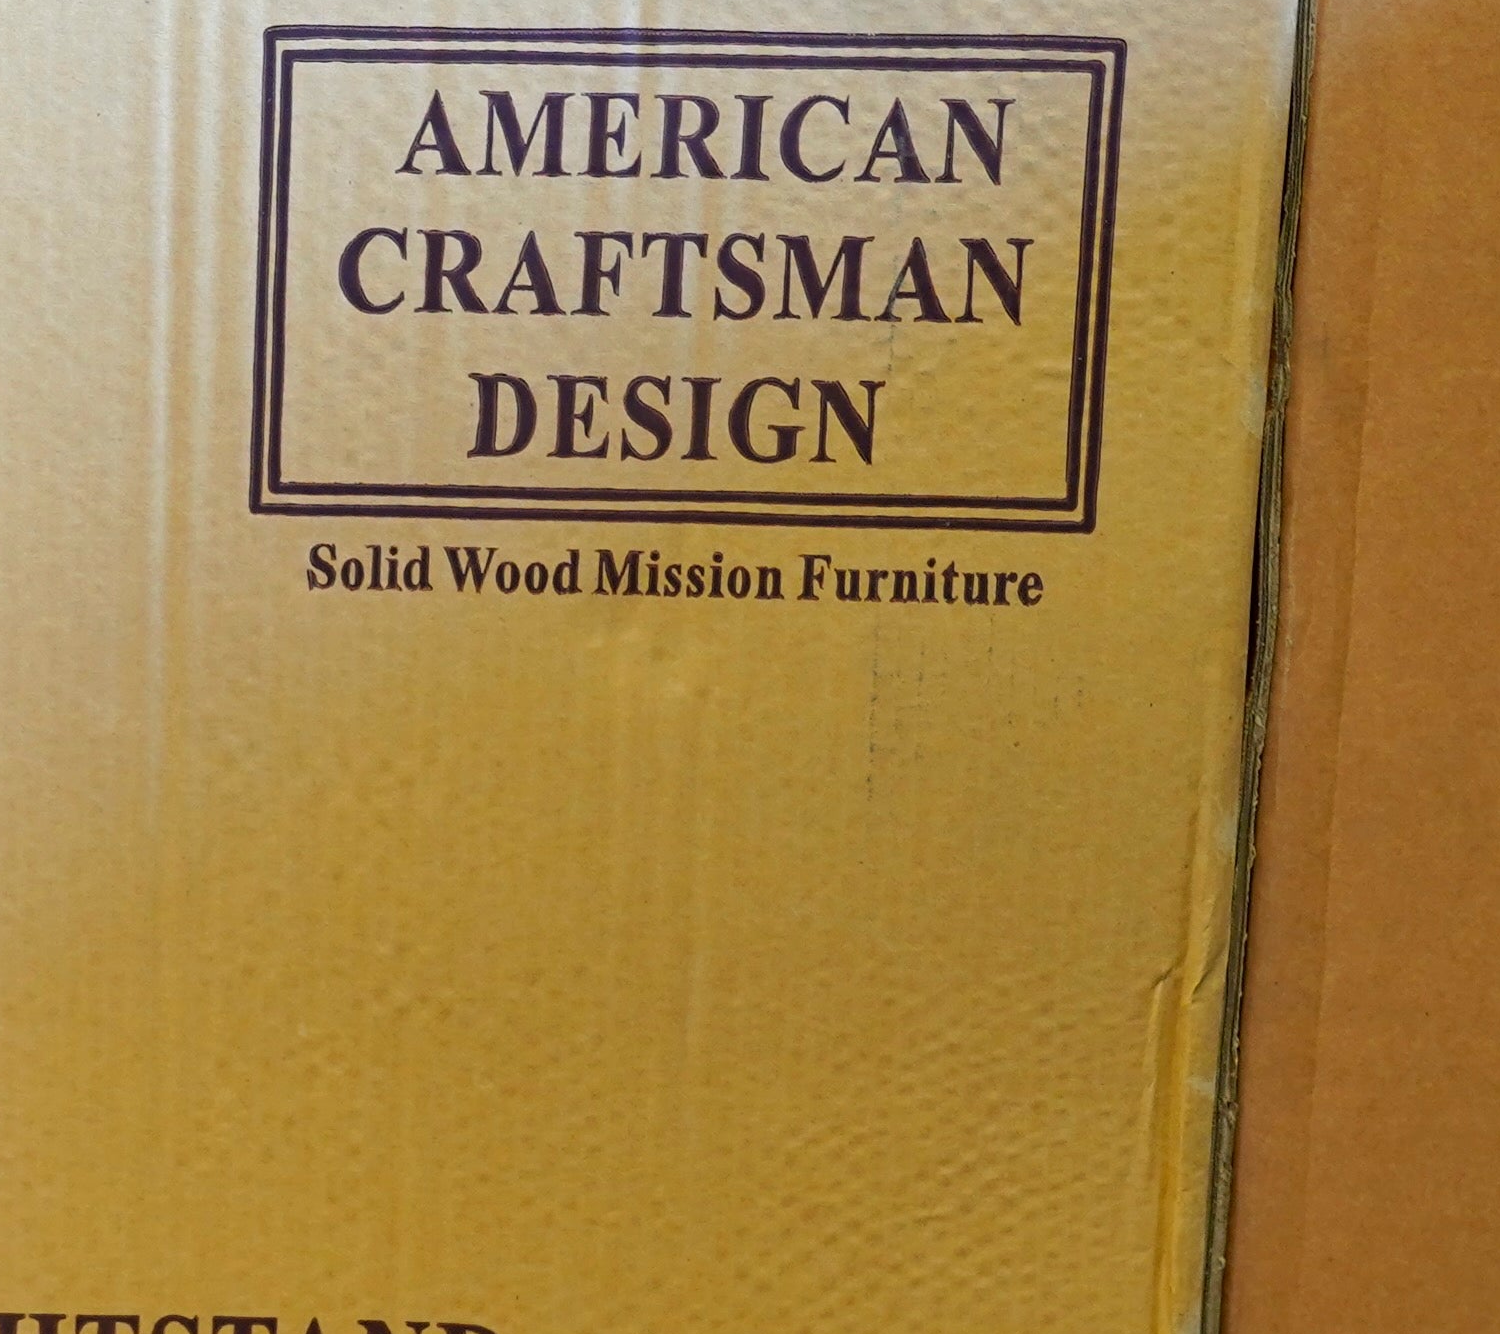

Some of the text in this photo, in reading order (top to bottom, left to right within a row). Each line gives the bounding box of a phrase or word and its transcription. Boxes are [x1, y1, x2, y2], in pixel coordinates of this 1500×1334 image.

[396, 90, 1015, 185] AMERICAN
[339, 228, 1034, 326] CRAFTSMAN
[467, 373, 886, 465] DESIGN
[307, 544, 1043, 607] Solid Wood Mission Furniture
